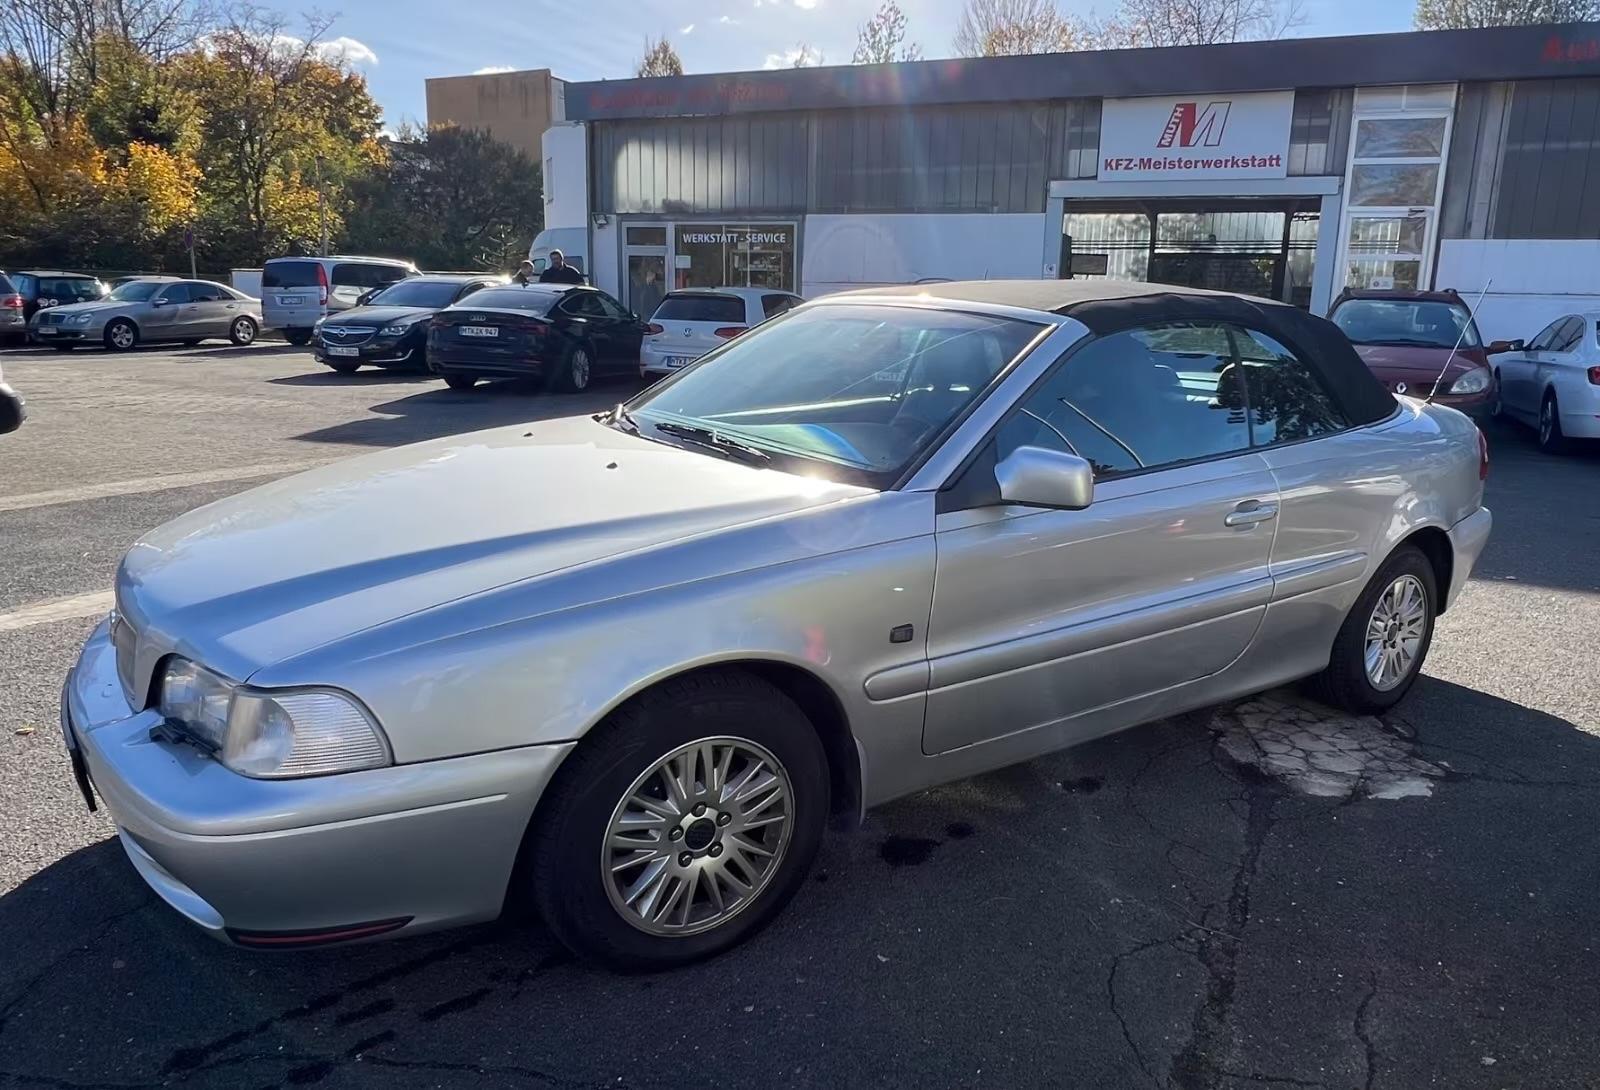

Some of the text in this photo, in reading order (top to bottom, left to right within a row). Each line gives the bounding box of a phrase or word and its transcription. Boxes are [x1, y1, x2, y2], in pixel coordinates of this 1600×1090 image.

[1161, 106, 1185, 146] MUTH
[1104, 155, 1281, 172] KFZ-Meisterwerkstatt
[683, 233, 738, 243] WERKSTATT
[746, 233, 786, 243] SERVICE
